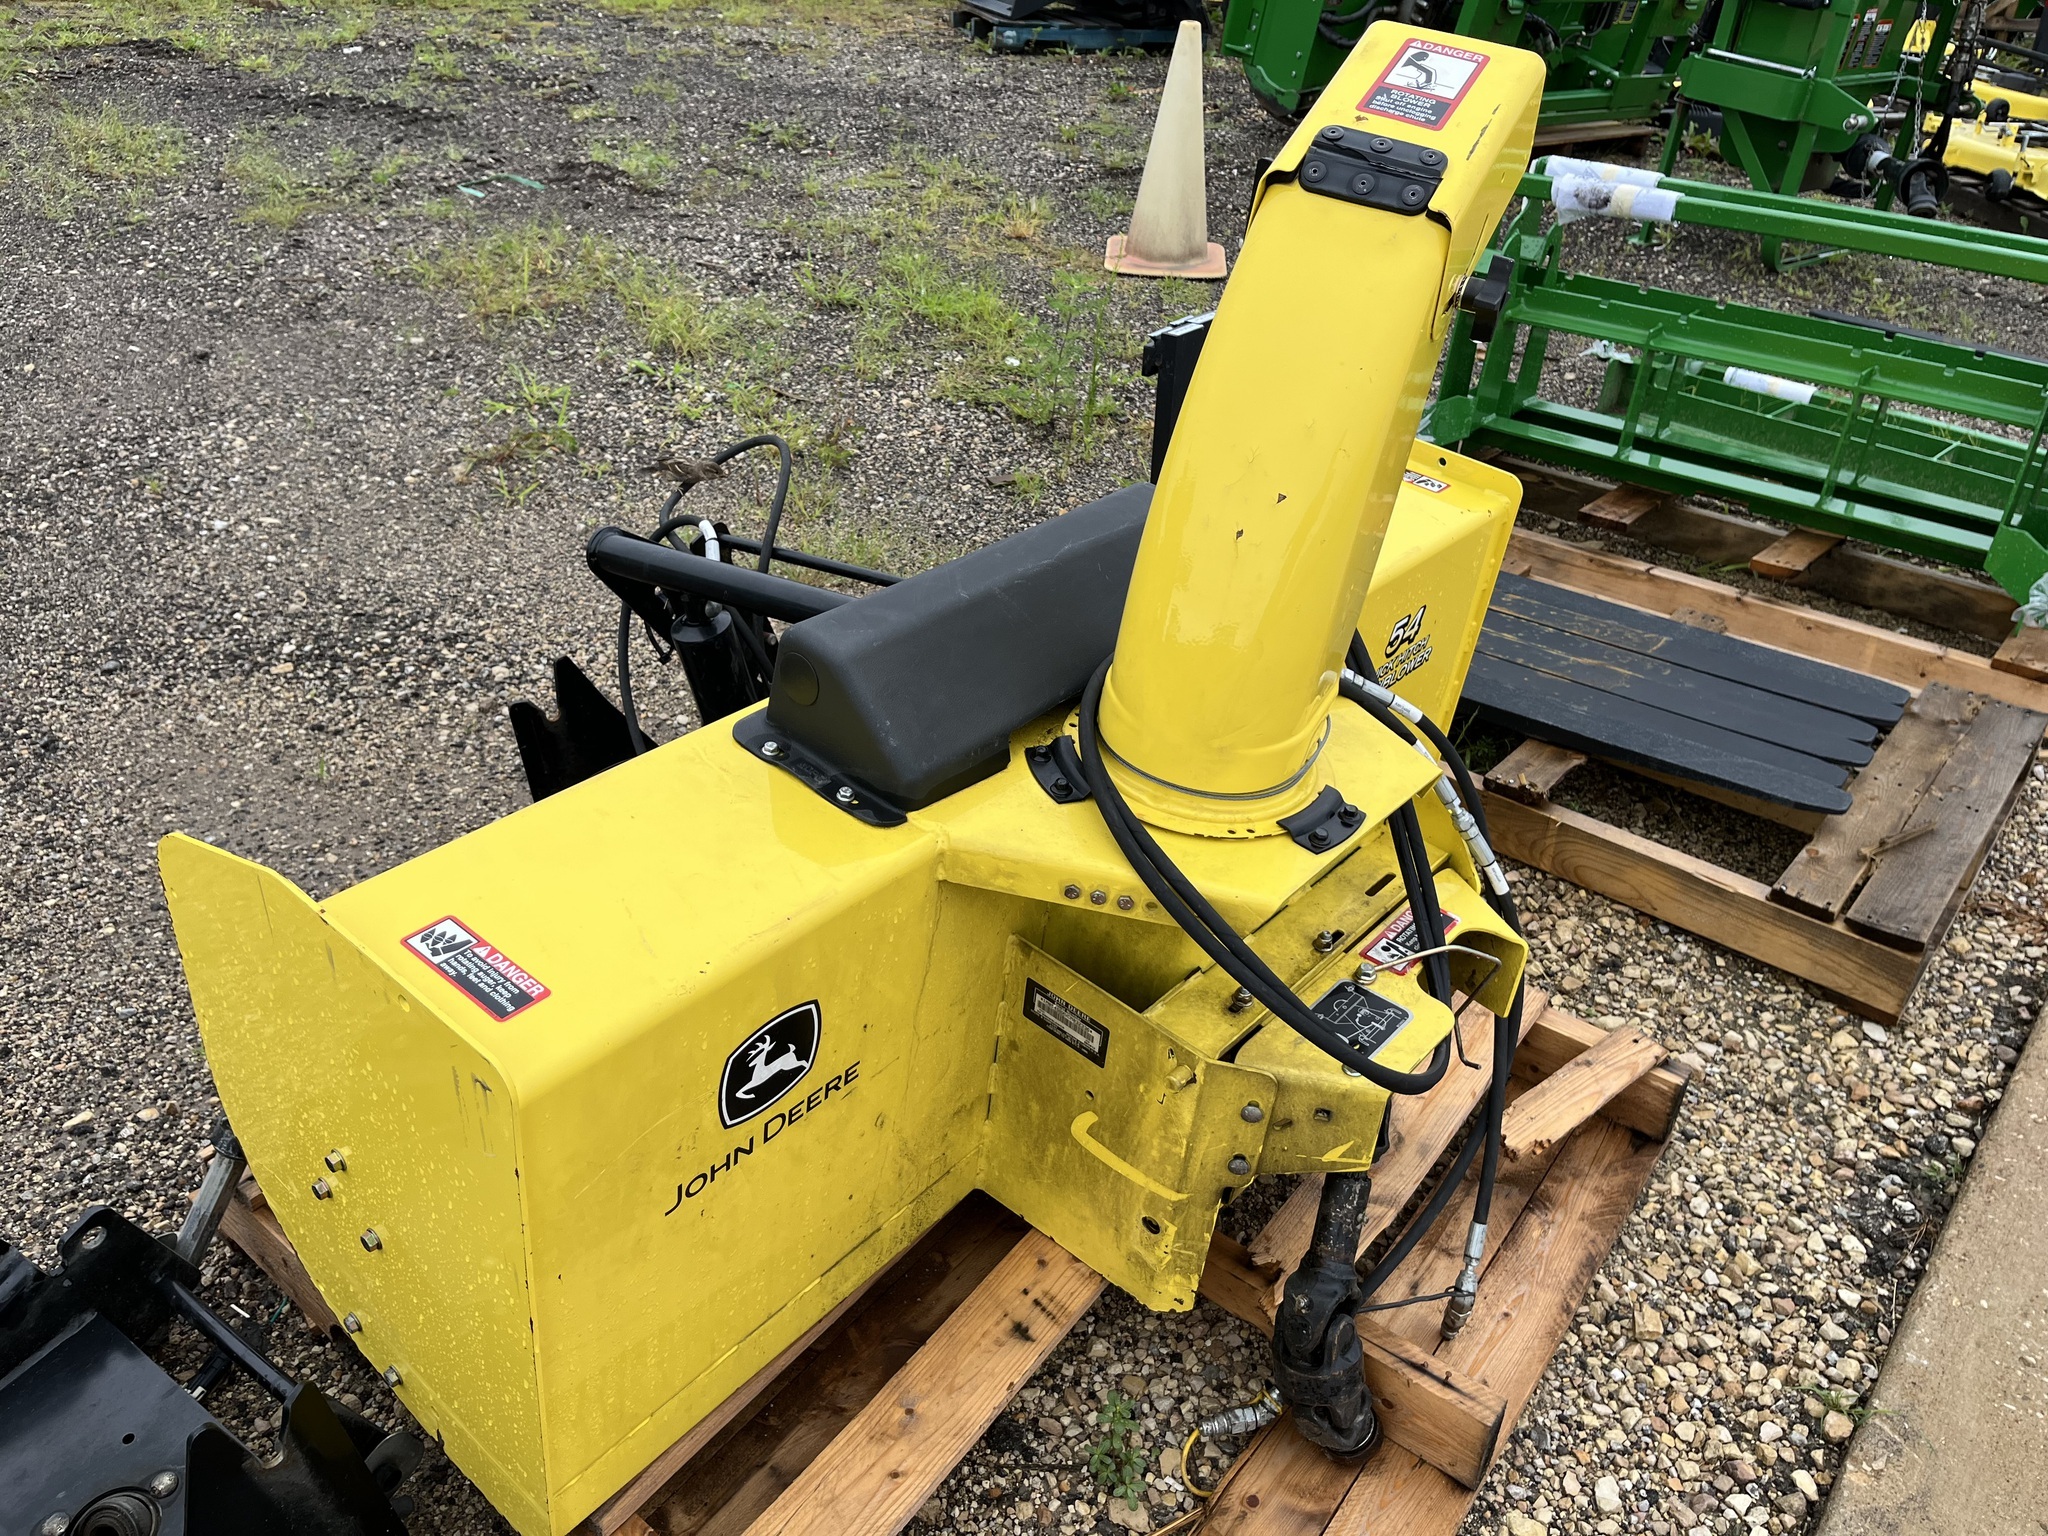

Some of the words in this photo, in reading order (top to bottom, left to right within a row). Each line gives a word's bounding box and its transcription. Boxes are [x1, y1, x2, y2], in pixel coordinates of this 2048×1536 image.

[1423, 42, 1484, 62] DANGER
[1371, 99, 1396, 109] before
[1396, 106, 1437, 121] unclogging
[1375, 95, 1394, 104] Shut
[1406, 104, 1433, 114] engine
[1390, 89, 1436, 105] ROTATING
[1390, 94, 1431, 108] BLOWER
[1368, 104, 1405, 116] discharge
[1405, 113, 1426, 122] chute
[1384, 604, 1427, 659] 54
[1376, 655, 1399, 679] ICK
[1395, 633, 1431, 668] HITCH
[1378, 646, 1433, 690] BLOWER
[1390, 908, 1414, 934] DANG
[1395, 921, 1417, 943] ROTATIN
[439, 962, 458, 977] away.
[455, 954, 480, 974] rotating
[477, 971, 497, 988] auger,
[495, 984, 512, 999] keep
[464, 949, 474, 958] To
[471, 956, 491, 971] avoid
[486, 967, 507, 984] injury
[503, 981, 520, 994] from
[486, 953, 545, 998] DANGER
[447, 957, 468, 976] hands,
[466, 972, 482, 984] feet
[478, 982, 494, 993] and
[489, 991, 516, 1012] clothing
[664, 1135, 754, 1217] JOHN
[763, 1060, 861, 1144] DEERE
